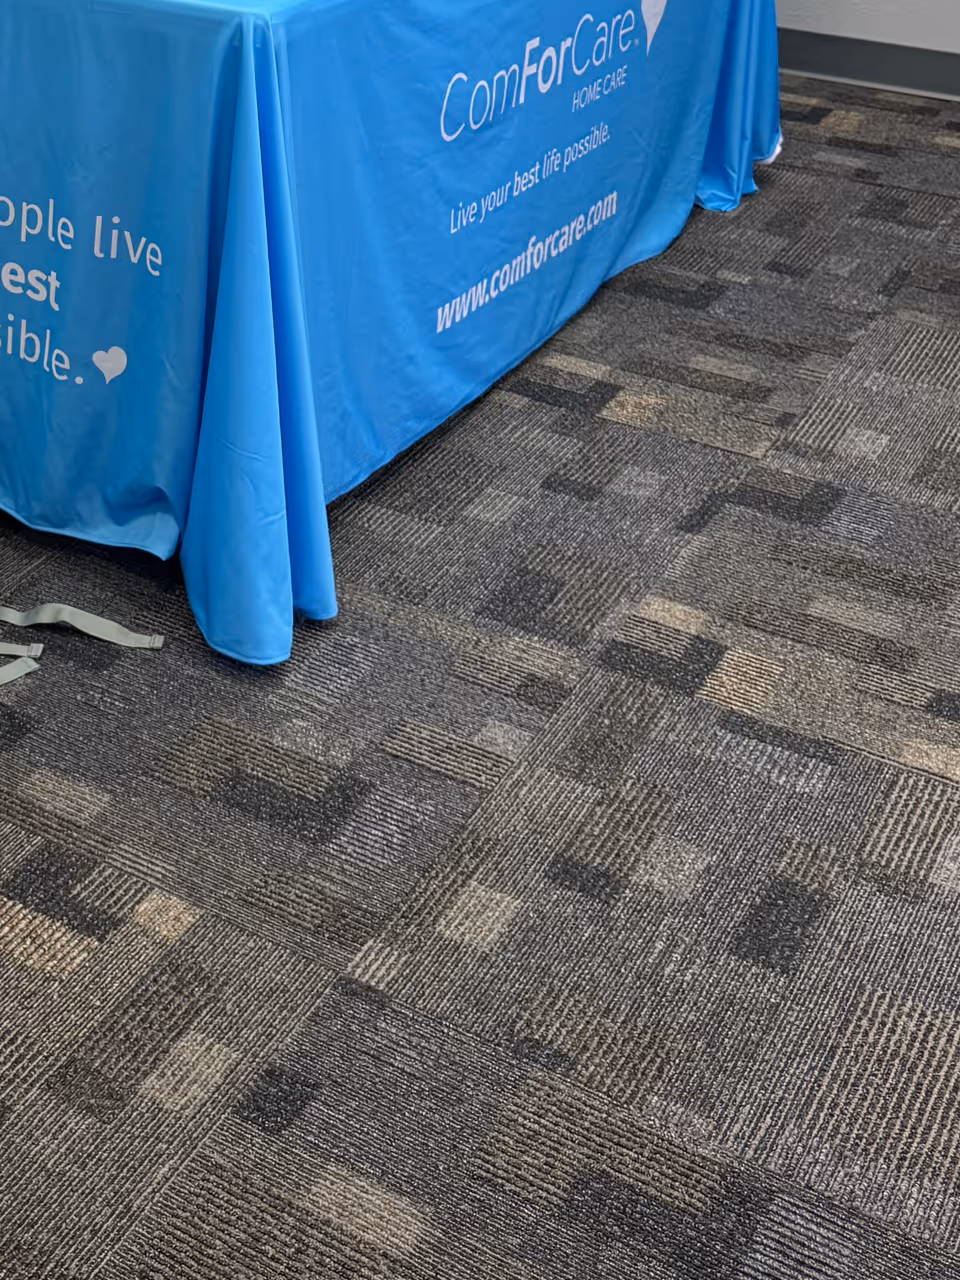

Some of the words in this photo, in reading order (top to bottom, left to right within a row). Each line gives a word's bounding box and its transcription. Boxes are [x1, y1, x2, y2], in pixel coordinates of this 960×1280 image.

[439, 8, 636, 142] ComForCare
[571, 85, 602, 113] HOME
[602, 64, 628, 91] CARE
[449, 198, 478, 234] Live
[479, 180, 512, 224] your
[512, 161, 541, 199] best
[542, 148, 562, 179] life
[562, 122, 611, 173] possible.
[93, 215, 163, 277] live
[436, 190, 618, 334] www.comforcare.com
